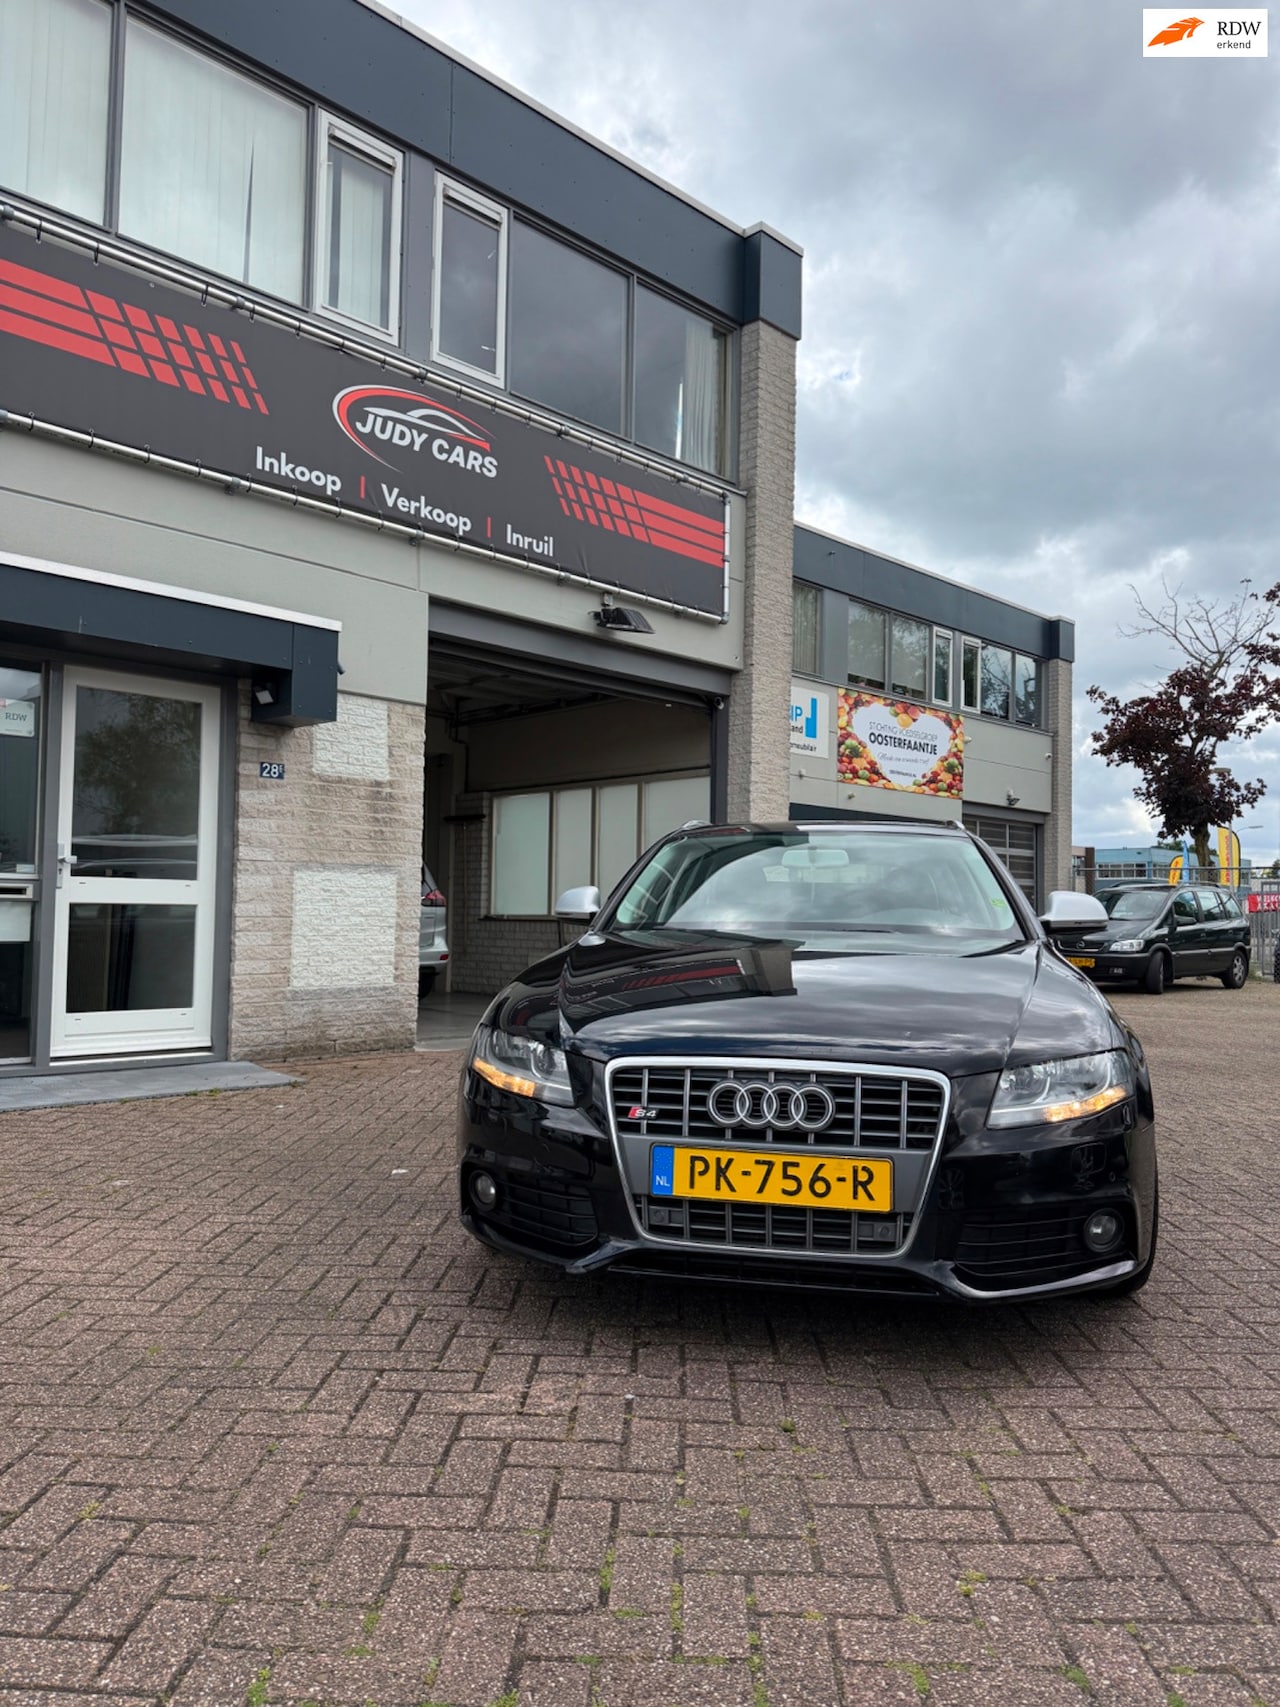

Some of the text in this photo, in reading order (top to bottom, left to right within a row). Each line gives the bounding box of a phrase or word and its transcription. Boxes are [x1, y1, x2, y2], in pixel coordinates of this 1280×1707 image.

[355, 413, 499, 479] JUDY CARS
[256, 446, 554, 557] Inkoop Verkoop Inruil
[5, 712, 27, 721] RDW
[791, 725, 804, 734] and
[868, 731, 938, 756] OOSTERFAANTJE
[635, 1108, 657, 1117] S4
[655, 1155, 875, 1201] NL PK-756-R
